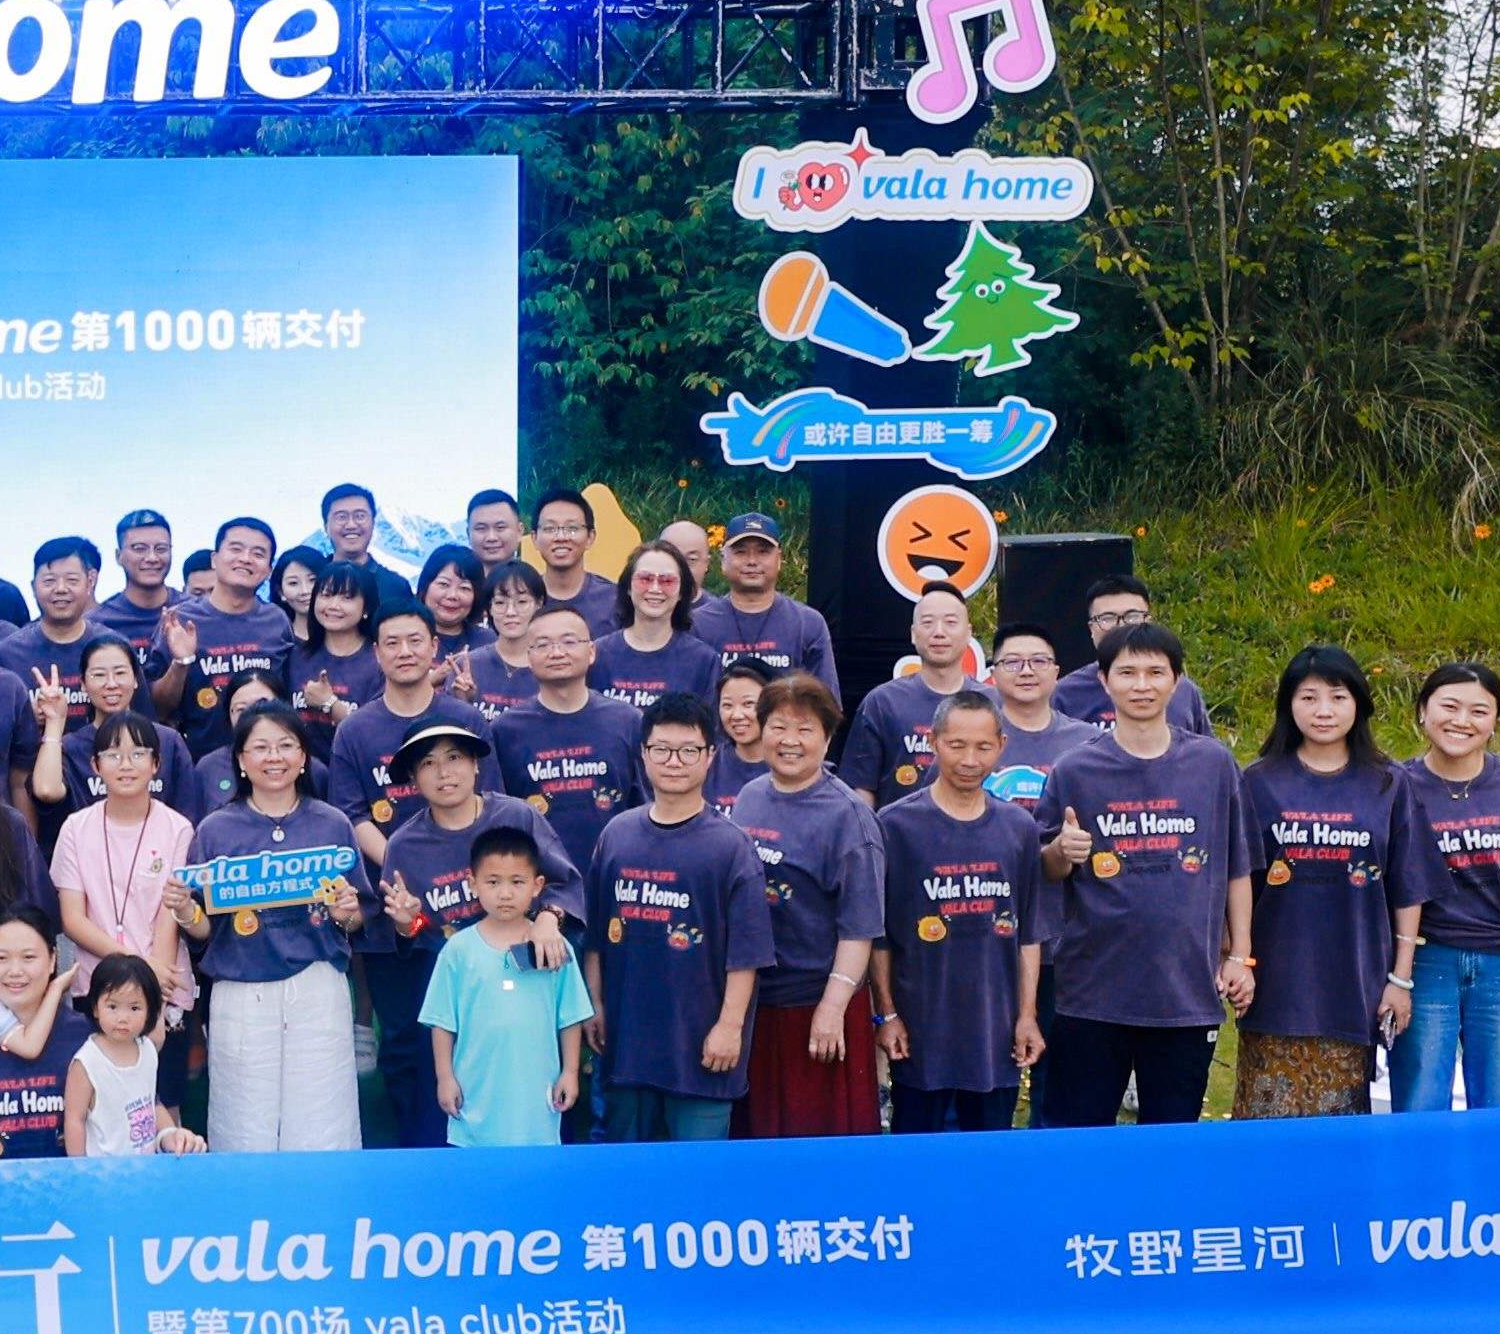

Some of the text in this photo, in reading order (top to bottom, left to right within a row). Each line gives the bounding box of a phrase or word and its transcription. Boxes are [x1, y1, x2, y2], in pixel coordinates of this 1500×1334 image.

[752, 167, 1073, 201] I vala home
[71, 308, 365, 353] 第1000辆交付
[803, 418, 994, 447] 或许自由更胜一筹
[200, 654, 271, 676] Vala Home
[527, 758, 607, 782] Vala Home
[1096, 812, 1196, 837] Vala Home
[1271, 822, 1371, 848] Vala Home
[260, 848, 355, 880] home
[219, 876, 315, 900] 的自由方程式
[425, 887, 461, 912] Vala
[641, 880, 691, 909] Home
[923, 874, 1011, 901] Vala Home
[21, 1090, 65, 1114] Hom
[141, 1214, 914, 1284] vala home 第1000辆交付
[1064, 1223, 1305, 1280] 牧野星河
